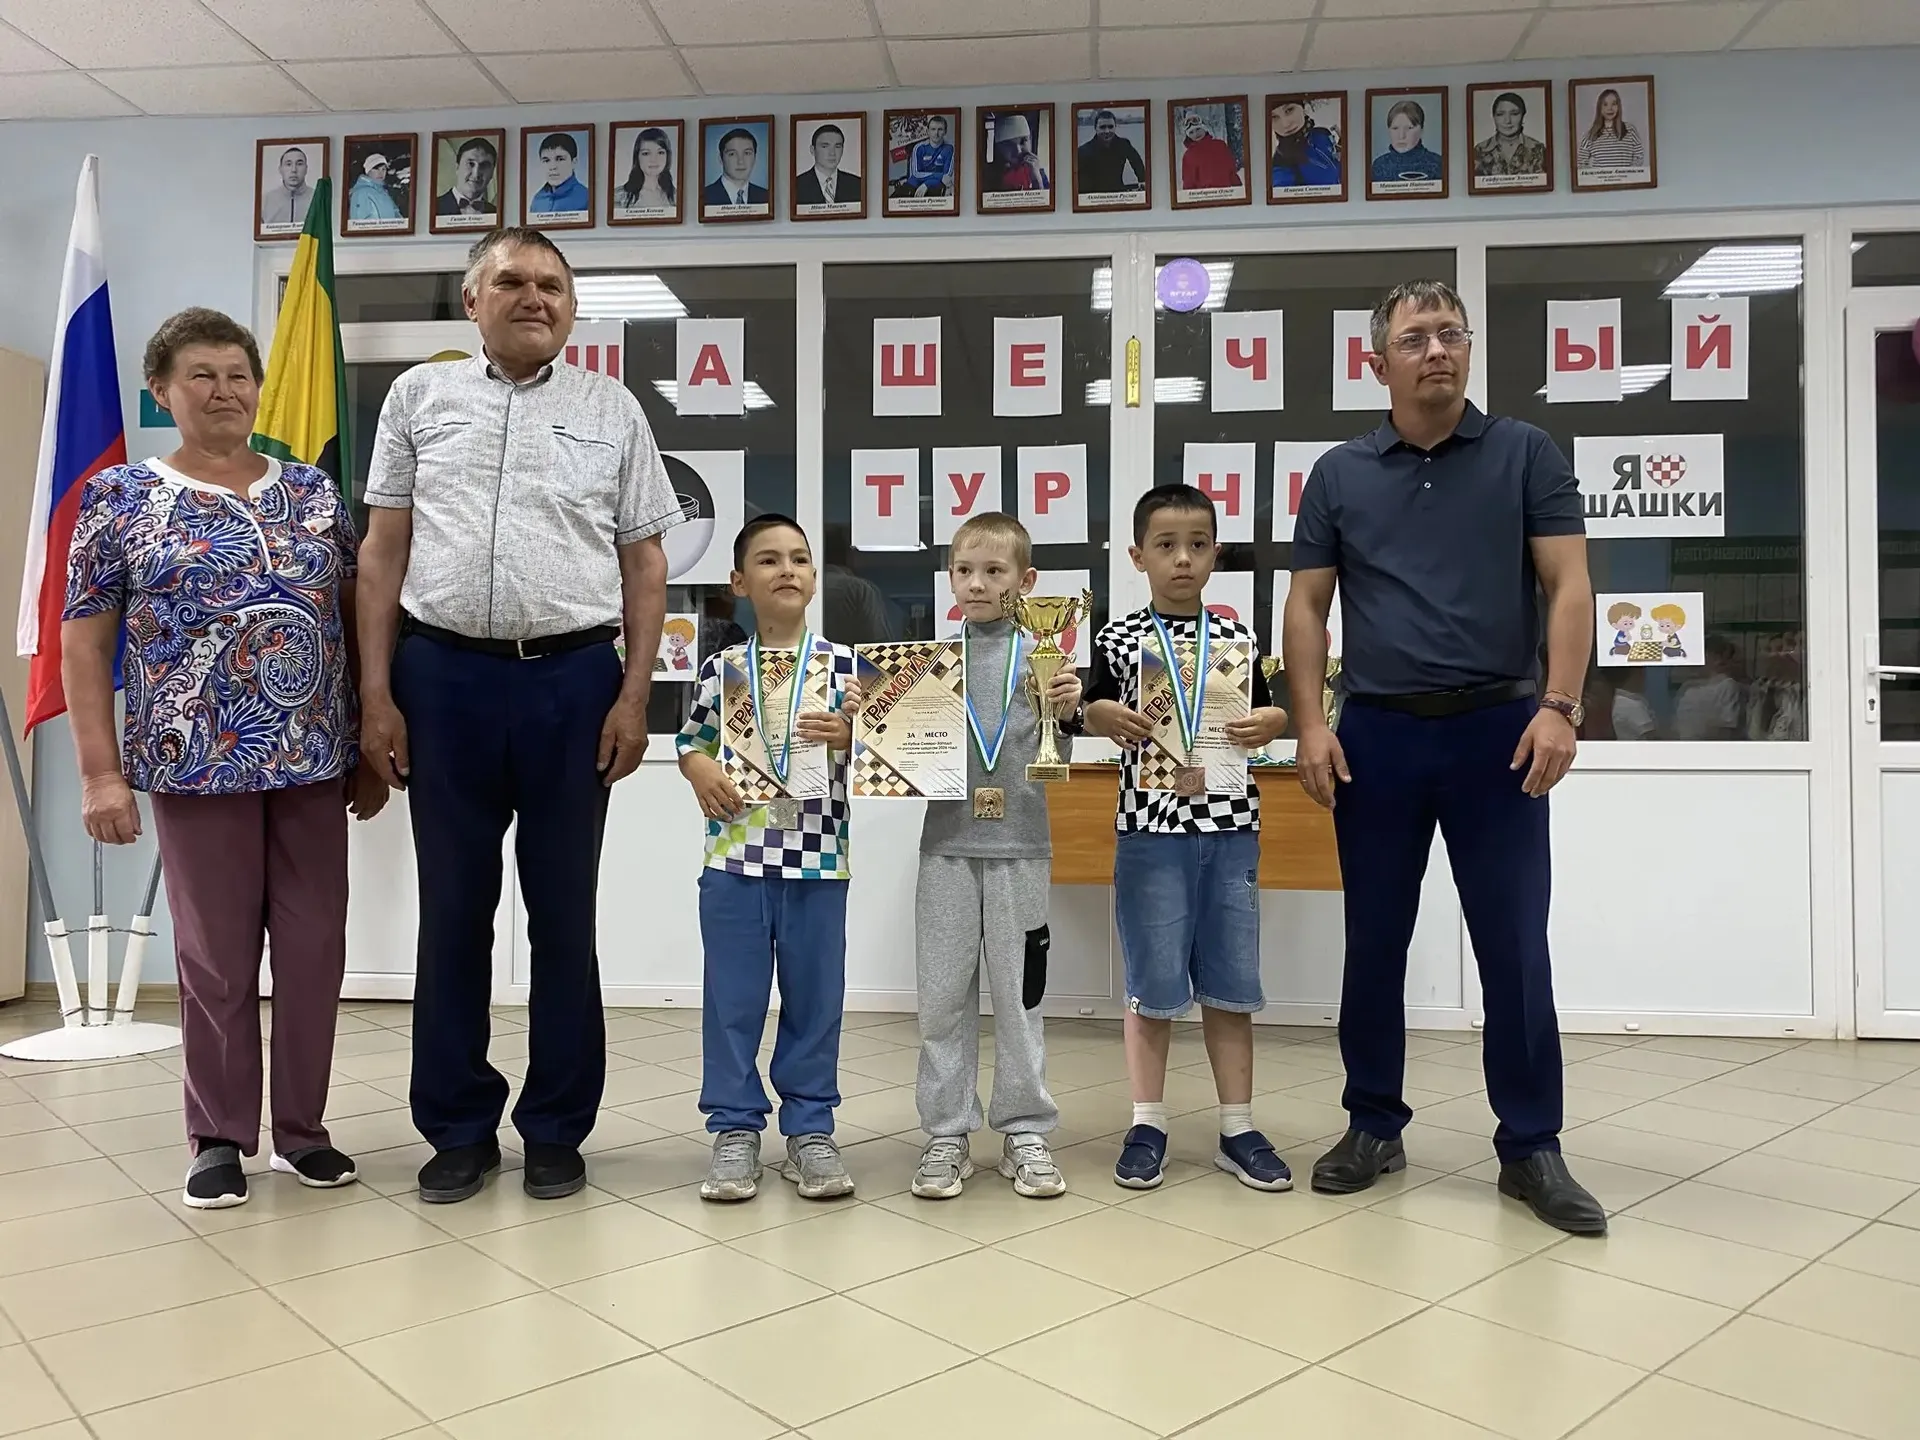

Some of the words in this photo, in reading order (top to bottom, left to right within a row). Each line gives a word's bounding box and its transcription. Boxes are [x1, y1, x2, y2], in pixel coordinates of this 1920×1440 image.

[688, 344, 731, 385] А
[881, 343, 937, 386] Ш
[1225, 338, 1267, 380] Ч
[1554, 326, 1614, 371] Ы
[1686, 313, 1731, 369] Й
[865, 475, 905, 517] Т
[948, 473, 986, 515] У
[1034, 472, 1071, 514] Р
[1612, 454, 1642, 490] Я
[1582, 491, 1722, 518] ШАШКИ
[862, 653, 931, 730] ГРАМОТА
